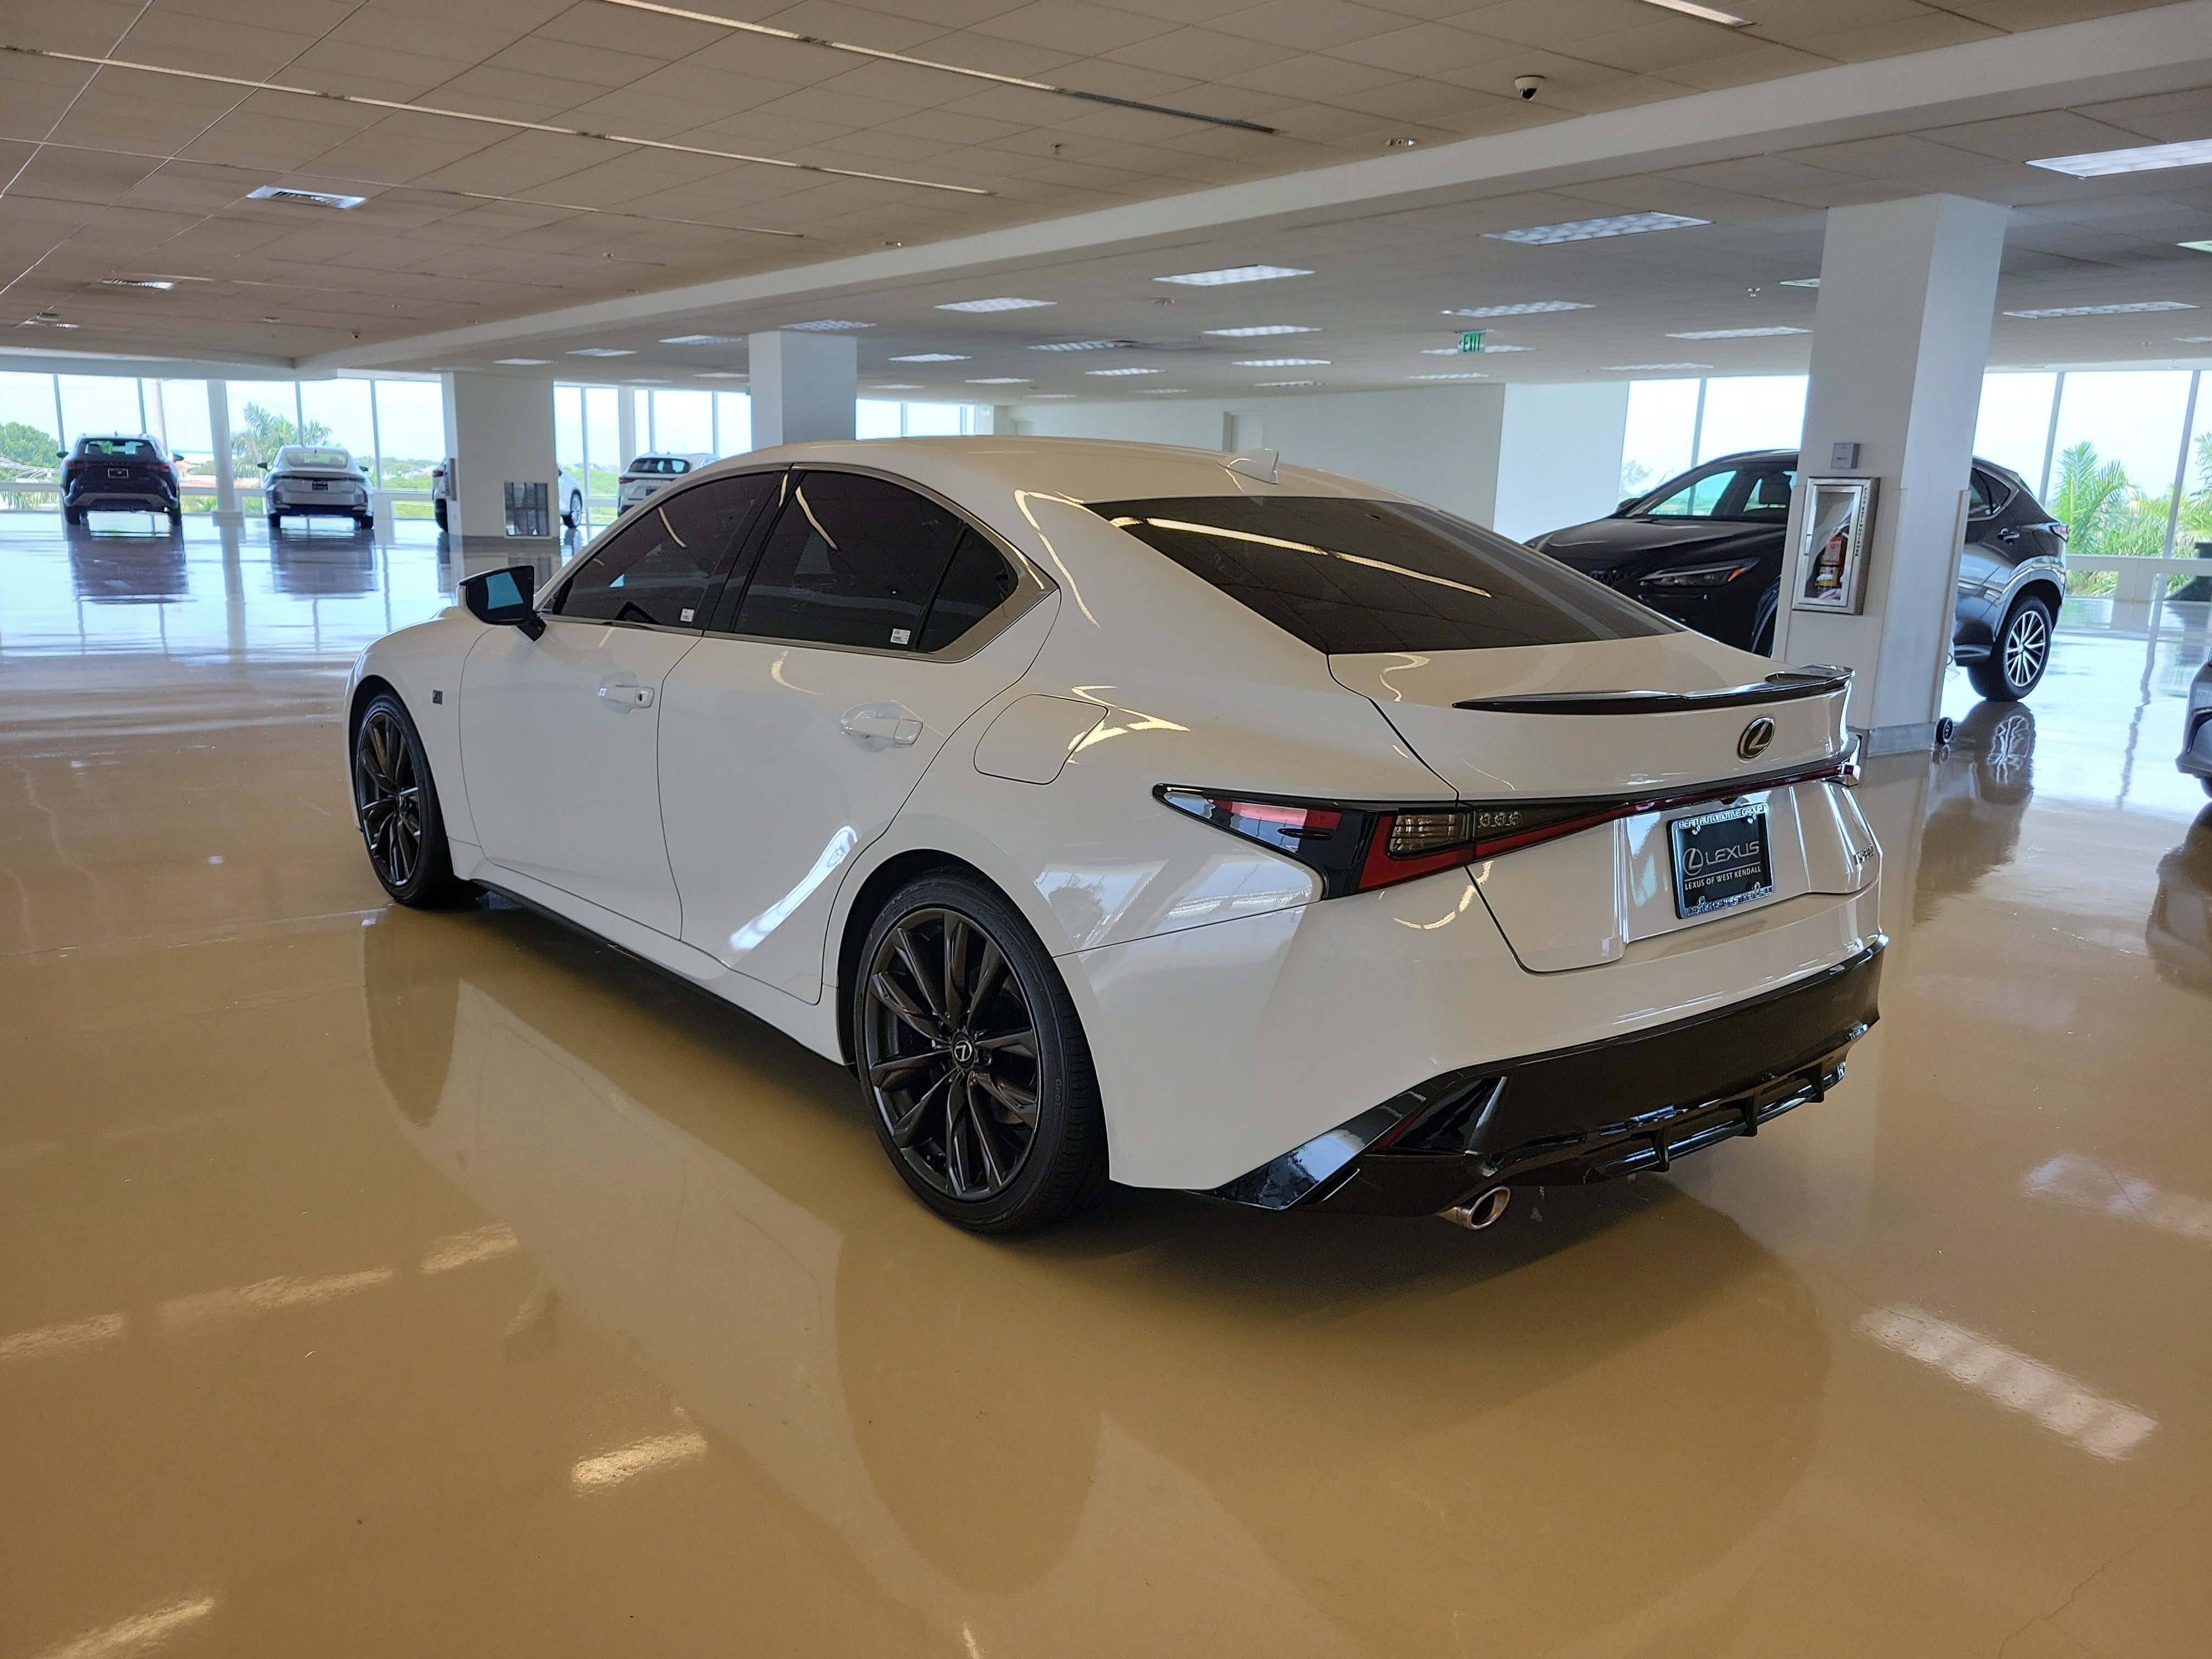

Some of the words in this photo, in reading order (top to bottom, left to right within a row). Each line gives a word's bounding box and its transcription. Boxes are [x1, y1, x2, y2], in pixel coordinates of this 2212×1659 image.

[1463, 332, 1482, 352] EXIT
[1679, 819, 1699, 829] BEAN
[1700, 810, 1741, 825] AUTOMOTIVE
[1742, 805, 1764, 816] GROUP
[1705, 840, 1759, 865] LEXUS
[1685, 880, 1705, 890] LEXUS
[1706, 877, 1714, 885] OF
[1716, 872, 1733, 882] WEST
[1734, 865, 1761, 878] KENDALL
